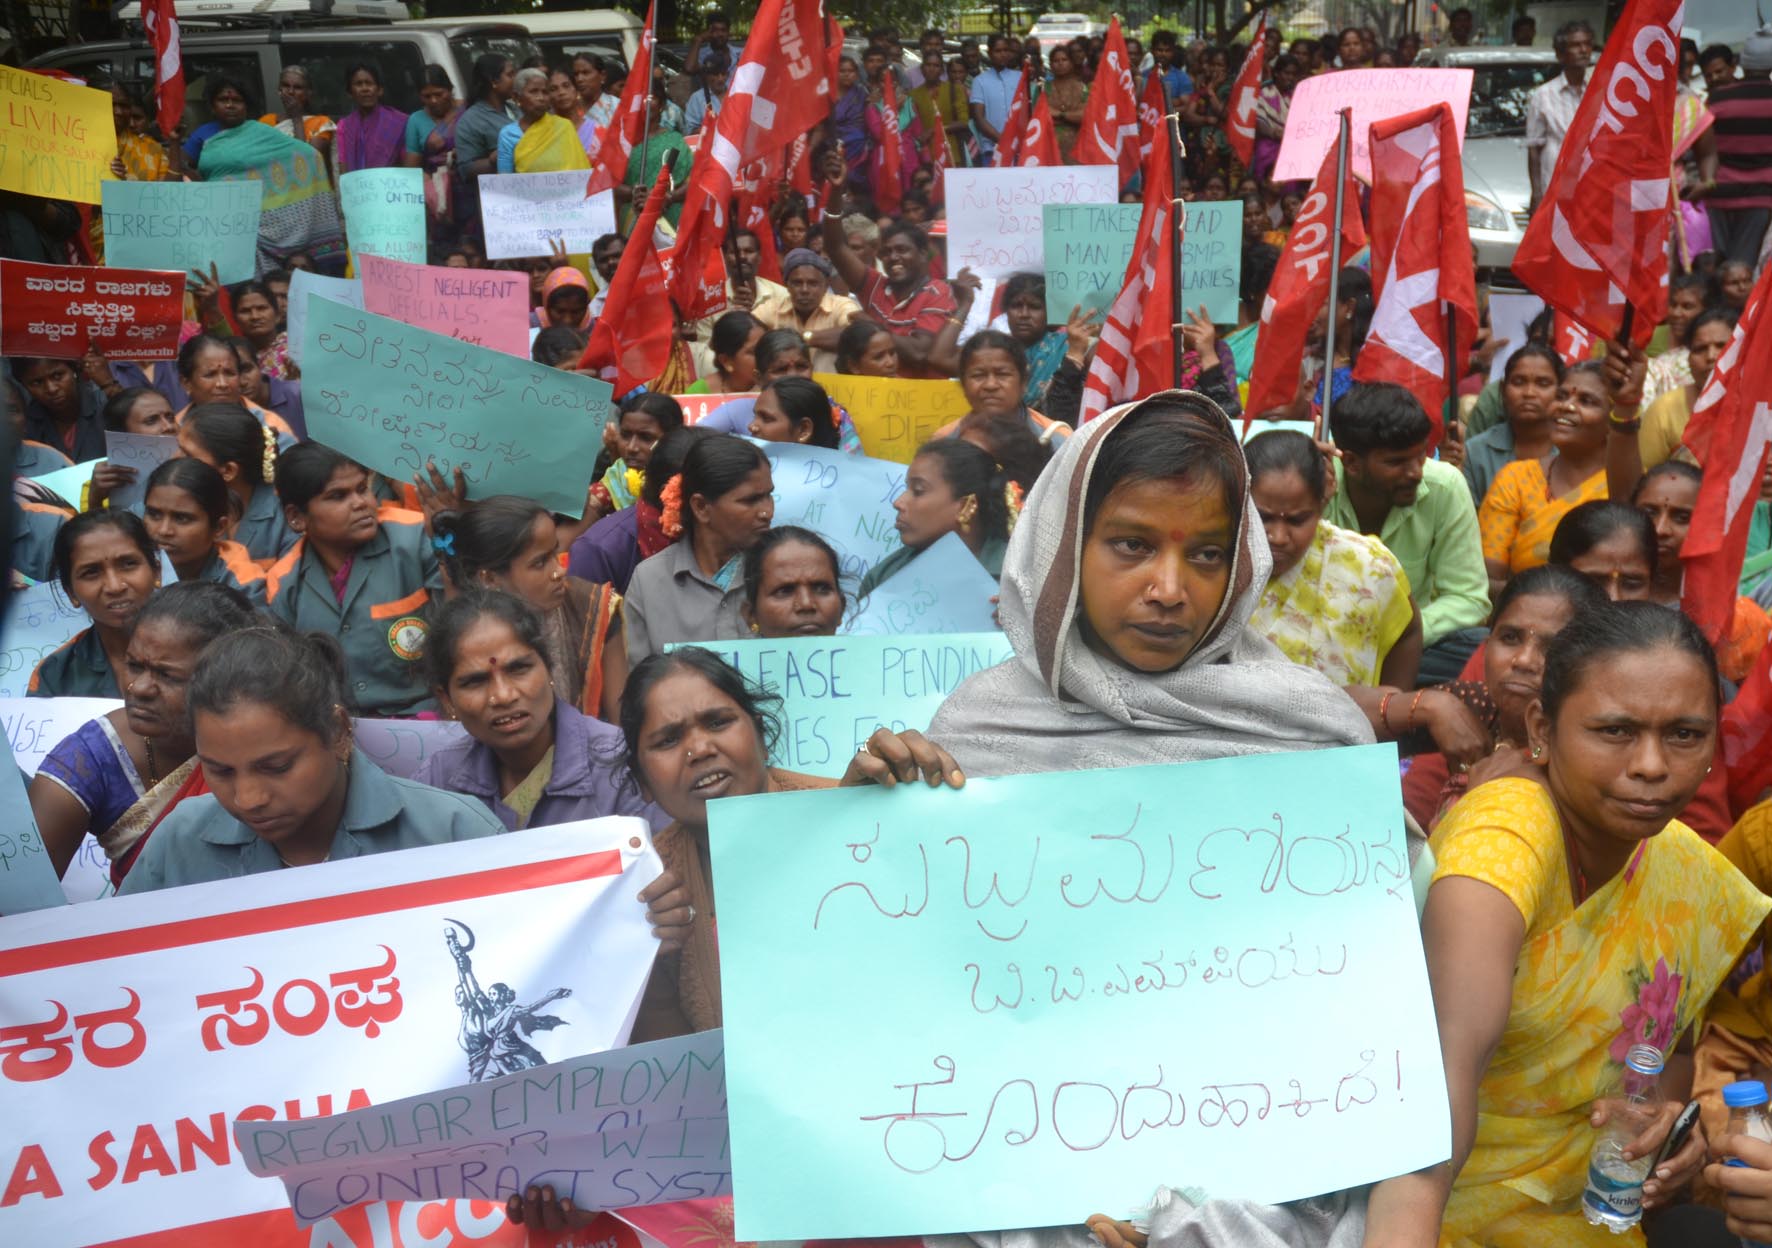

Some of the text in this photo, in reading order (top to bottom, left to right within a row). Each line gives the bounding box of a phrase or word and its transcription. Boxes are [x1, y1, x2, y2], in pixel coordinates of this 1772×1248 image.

[9, 101, 89, 144] LIVING
[386, 191, 402, 204] ON
[402, 192, 425, 206] TIME
[1052, 207, 1223, 234] IT TAKES EAD
[536, 228, 563, 240] BBMP
[1065, 243, 1110, 265] MAN
[1183, 241, 1225, 265] BMP
[26, 277, 86, 294] ವಾರದ
[369, 260, 518, 300] ARREST NEGLIGENT
[1048, 270, 1068, 290] TO
[1076, 270, 1111, 292] PAY
[1182, 268, 1235, 290] LARIES
[28, 321, 77, 342] ಹಬ್ಬದ
[886, 389, 921, 410] ONE
[803, 459, 839, 489] DO
[801, 500, 828, 524] AT
[196, 944, 404, 1052] ಸಂಘ
[253, 1097, 473, 1169] REGULAR
[491, 1049, 728, 1131] EMPLOYM
[599, 1168, 733, 1209] SYST
